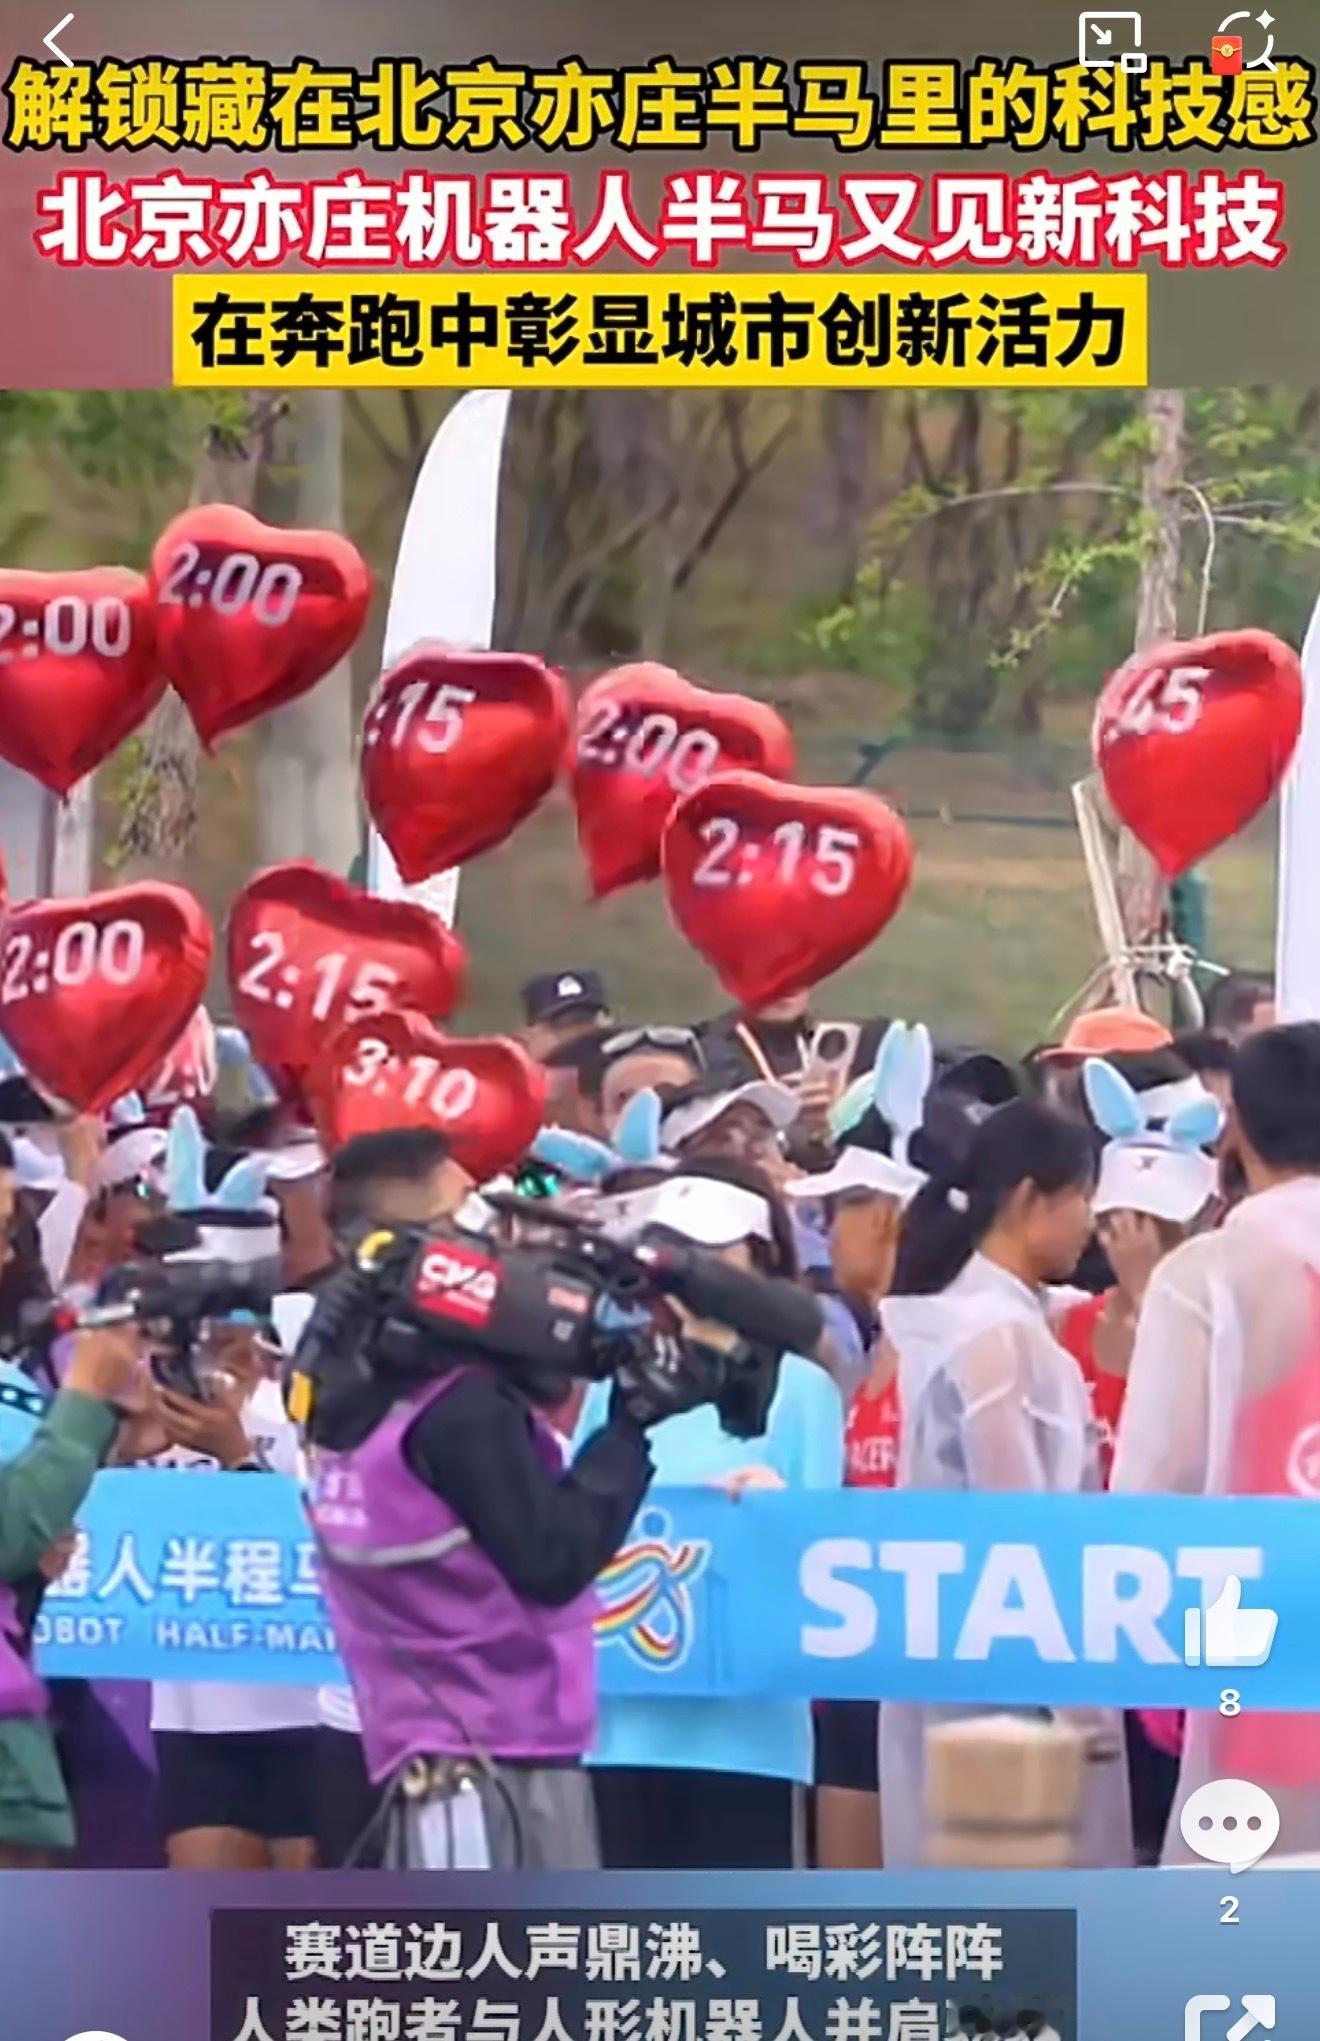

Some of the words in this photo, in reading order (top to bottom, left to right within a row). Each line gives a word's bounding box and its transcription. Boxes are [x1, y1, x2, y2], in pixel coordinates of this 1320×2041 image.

[157, 540, 303, 628] 2:00
[578, 698, 721, 794] 2:00
[693, 817, 862, 896] 2:15
[2, 919, 144, 1000] 2:00
[238, 931, 400, 1024] 2:15
[342, 1037, 477, 1120] 3:10
[799, 1538, 1263, 1665] START
